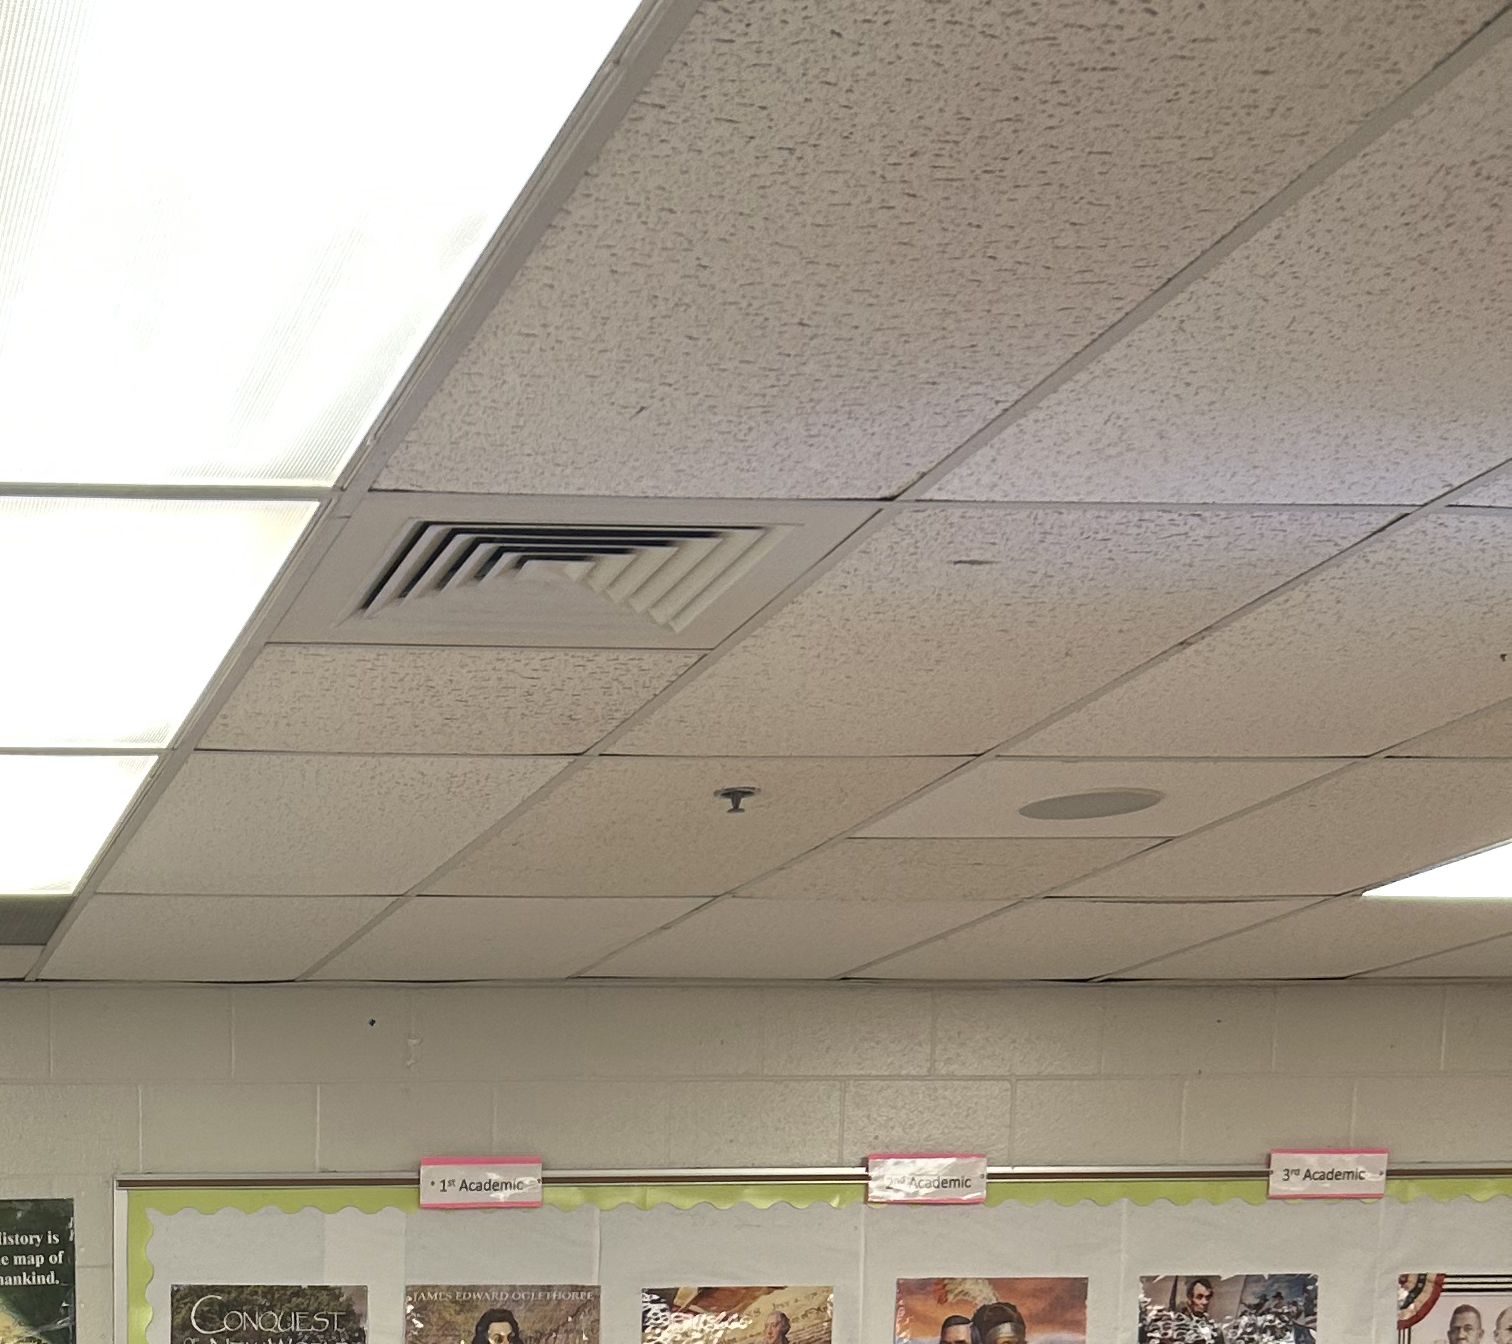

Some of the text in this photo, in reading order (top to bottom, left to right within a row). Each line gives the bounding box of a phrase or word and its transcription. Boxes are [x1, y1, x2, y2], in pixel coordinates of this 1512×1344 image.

[1282, 1168, 1366, 1182] 3rd Academic
[440, 1179, 524, 1193] 1st Academic
[909, 1176, 972, 1189] Academic
[47, 1231, 60, 1245] is
[13, 1255, 44, 1269] map
[49, 1251, 65, 1265] of
[412, 1291, 594, 1302] JAMES EDWARD OGLETHORPE
